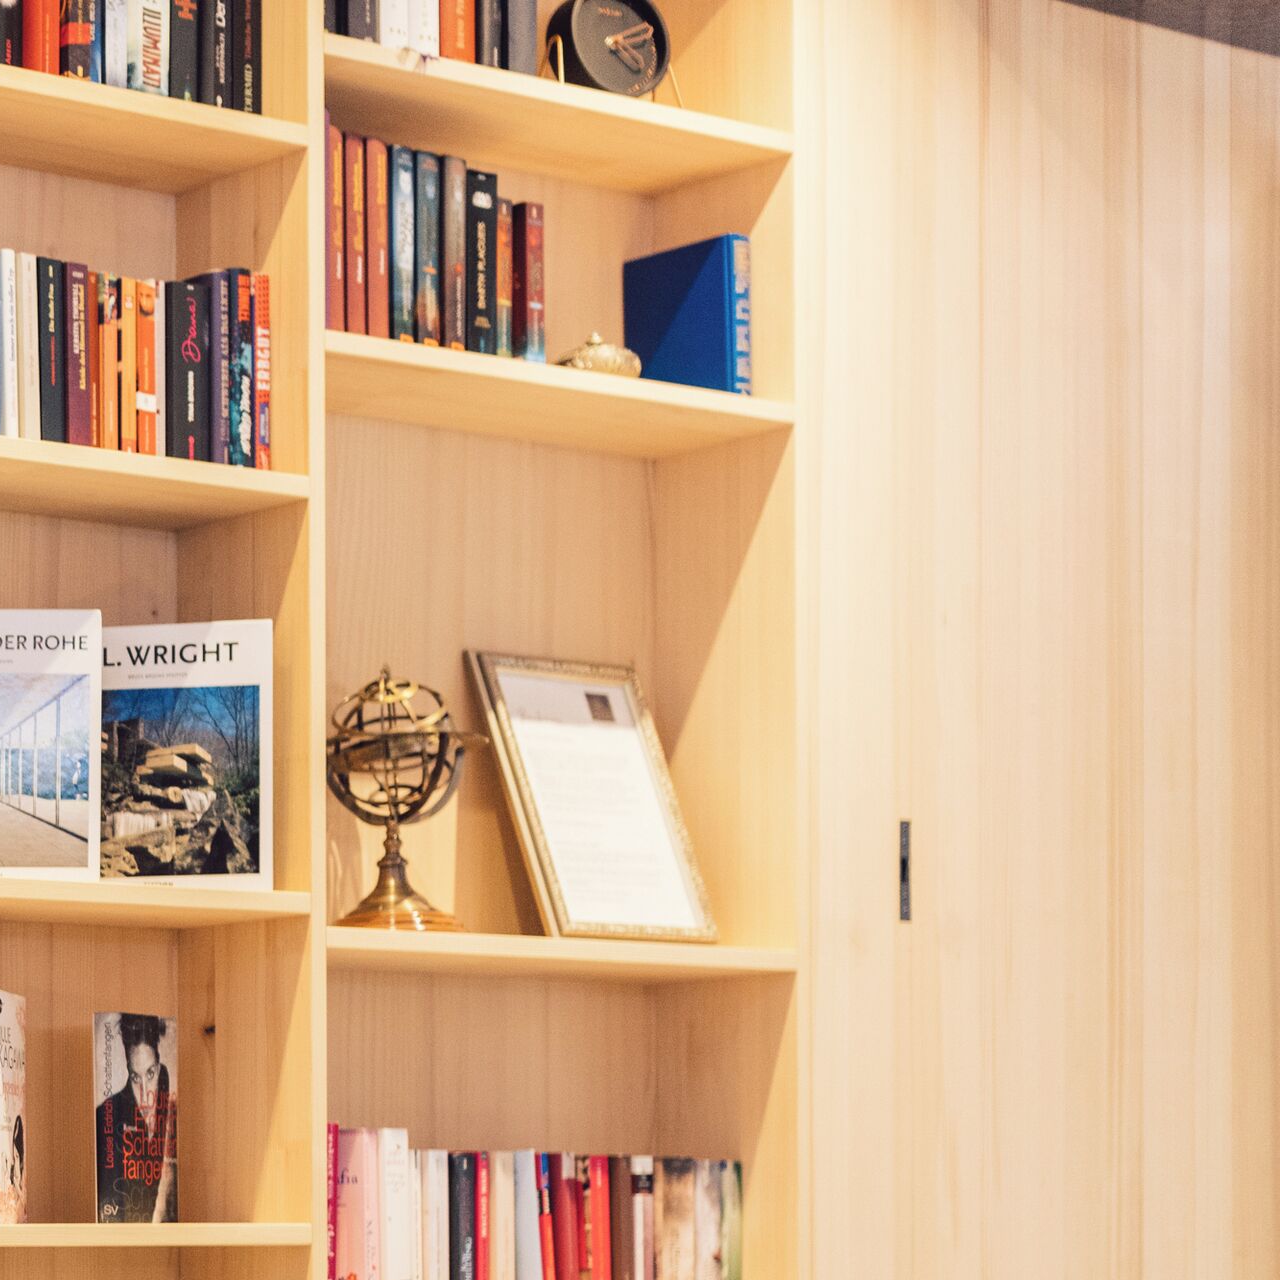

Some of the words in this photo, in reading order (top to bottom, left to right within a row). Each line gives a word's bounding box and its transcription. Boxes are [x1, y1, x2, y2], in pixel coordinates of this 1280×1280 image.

[142, 7, 162, 89] ILLUMINATI
[33, 635, 88, 651] ROHE
[102, 647, 122, 667] L.
[127, 642, 239, 666] WRIGHT
[104, 1023, 113, 1096] Schattenfangen
[104, 1101, 113, 1134] Erdrich
[105, 1136, 114, 1169] Louise
